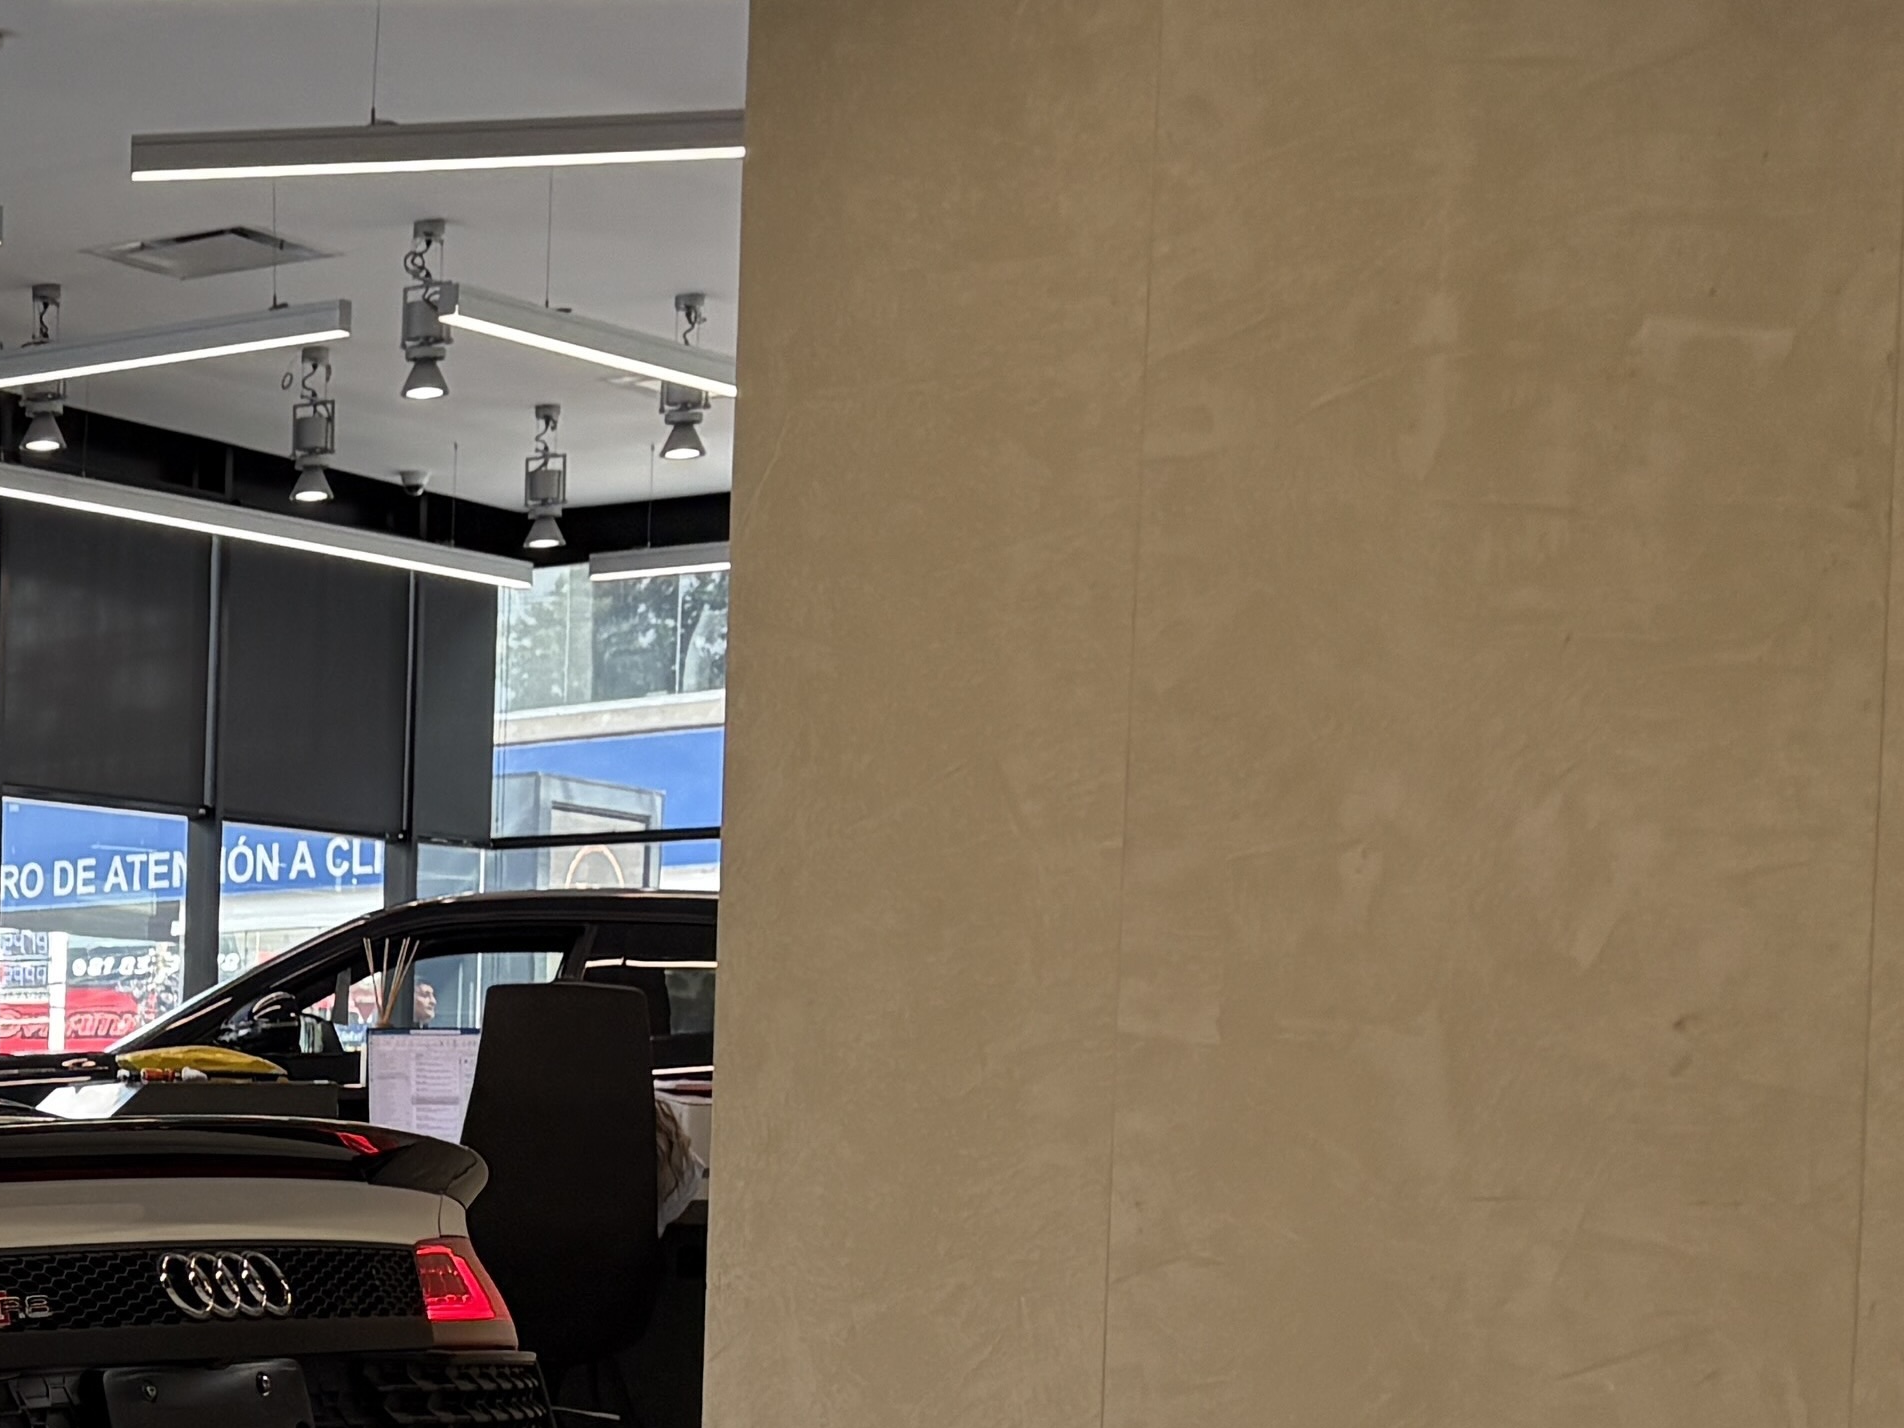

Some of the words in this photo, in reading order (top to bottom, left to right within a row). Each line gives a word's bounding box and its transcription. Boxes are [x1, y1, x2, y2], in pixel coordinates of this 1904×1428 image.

[53, 857, 96, 897] DE
[103, 836, 280, 893] ATENIÓN
[289, 840, 316, 880] A
